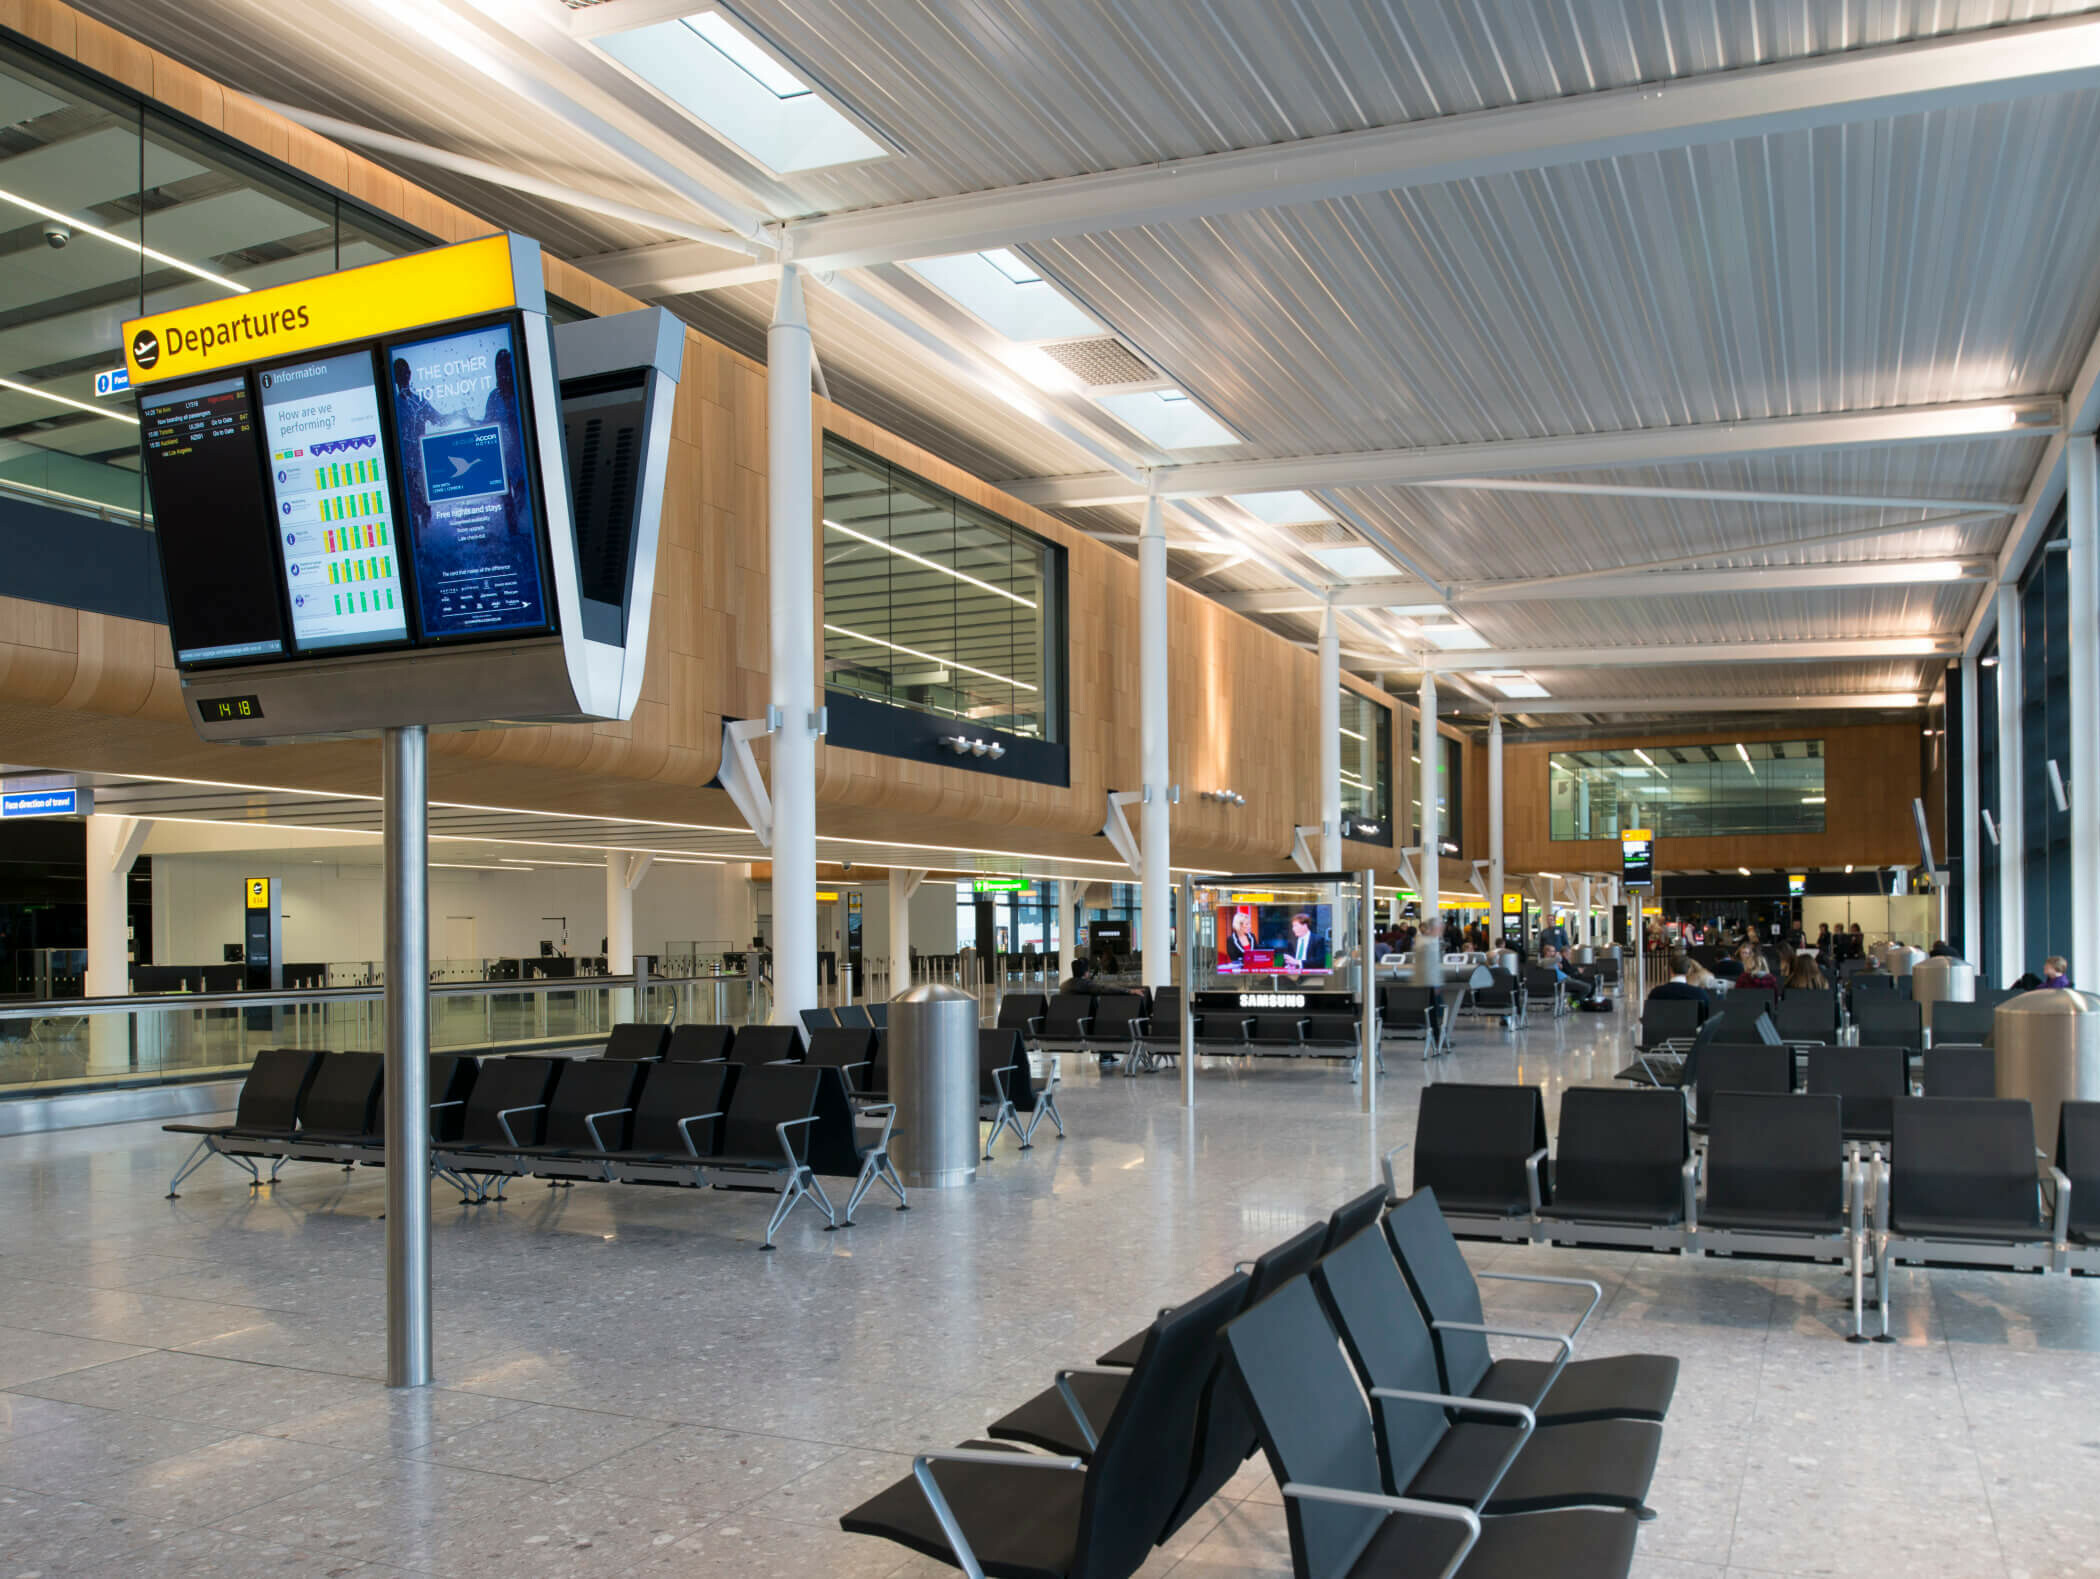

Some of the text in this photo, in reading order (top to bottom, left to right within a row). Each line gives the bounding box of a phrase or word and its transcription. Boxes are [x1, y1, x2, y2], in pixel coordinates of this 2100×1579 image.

[165, 305, 310, 357] Departures
[273, 365, 328, 384] Information
[416, 356, 487, 381] THE OTHER
[416, 375, 492, 402] TO ENJOY IT
[278, 404, 333, 422] How are we
[280, 415, 336, 438] performing?
[475, 433, 497, 442] ACCOR
[436, 510, 451, 519] Free
[472, 505, 484, 513] and
[485, 504, 502, 514] stays
[218, 700, 251, 717] 14 18
[18, 799, 44, 809] direction
[45, 798, 52, 807] of
[52, 797, 70, 807] travel
[1239, 994, 1305, 1008] SAMSUNG
